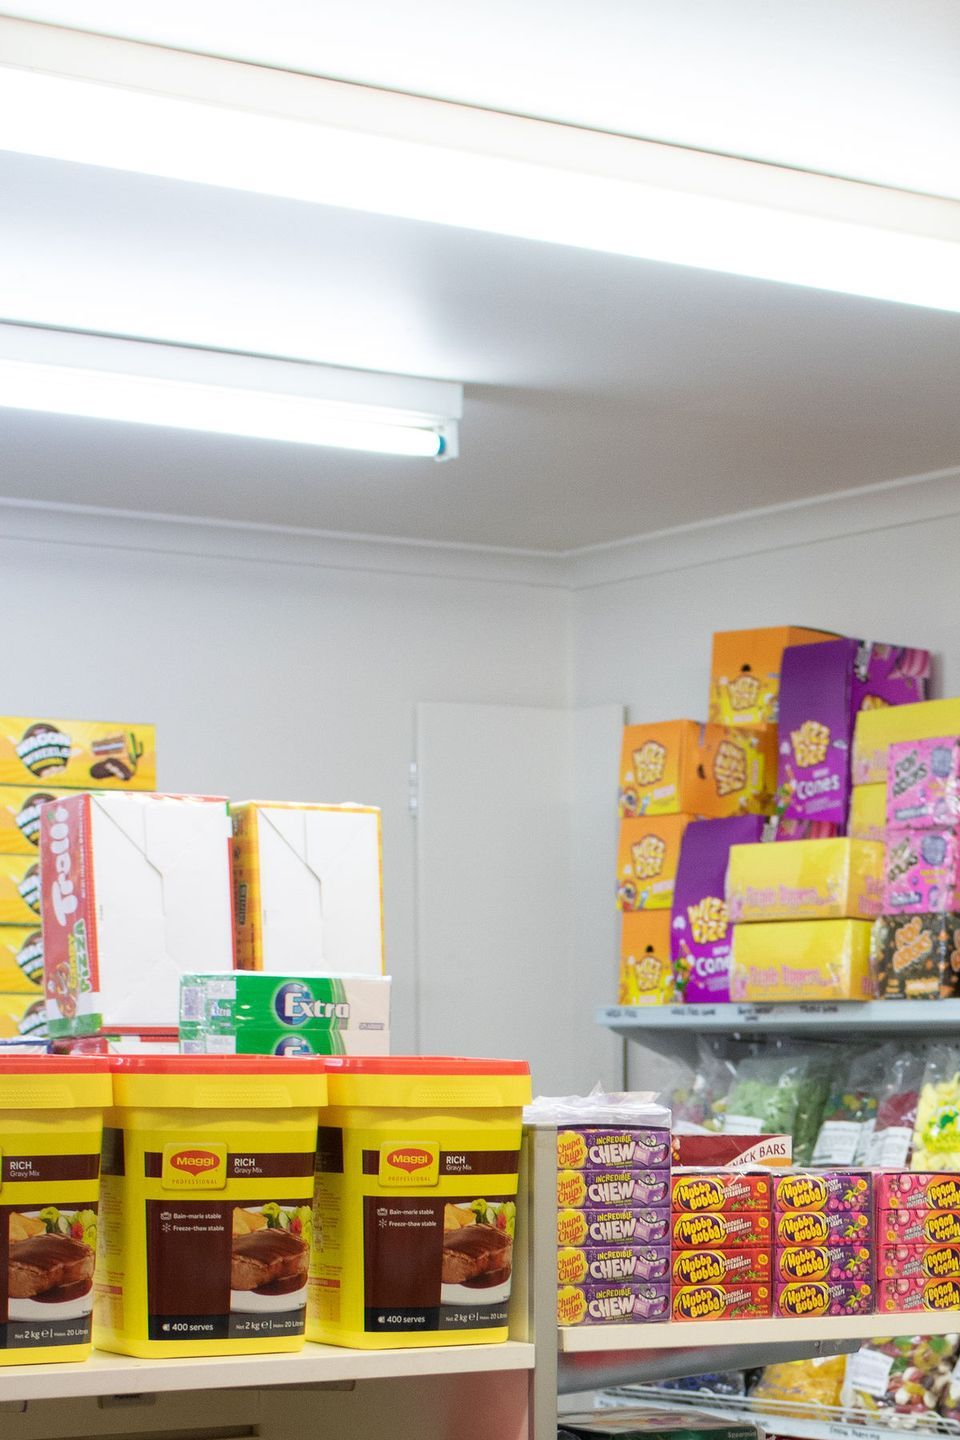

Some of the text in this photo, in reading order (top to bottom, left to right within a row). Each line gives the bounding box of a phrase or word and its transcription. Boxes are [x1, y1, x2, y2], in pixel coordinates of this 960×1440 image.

[284, 991, 351, 1019] Extra
[597, 1134, 633, 1145] INCREDIBLE
[589, 1142, 637, 1164] CHEW
[759, 1143, 787, 1156] BARS
[9, 1160, 32, 1170] RICH
[176, 1155, 214, 1168] Maggi
[234, 1158, 255, 1167] RICH
[392, 1153, 428, 1166] Maggi
[446, 1155, 466, 1165] RICH
[10, 1170, 29, 1178] Gravy
[234, 1166, 263, 1175] Gravy Mix
[446, 1165, 463, 1173] Gravy
[588, 1180, 636, 1203] CHEW
[680, 1181, 711, 1199] Hubba
[783, 1179, 814, 1199] Hubba
[689, 1191, 721, 1211] Bubba
[793, 1188, 823, 1208] Bubba
[173, 1212, 222, 1220] Bain-marie stable
[389, 1208, 434, 1216] Bain-marie stable
[597, 1212, 633, 1222] INCREDIBLE
[173, 1224, 225, 1232] Freeze-thaw stable
[388, 1219, 437, 1228] Freeze-thaw stable
[589, 1218, 637, 1242] CHEW
[682, 1216, 712, 1235] Hubba
[785, 1216, 815, 1235] Hubba
[691, 1227, 722, 1246] Bubba
[794, 1224, 824, 1244] Bubba
[589, 1295, 636, 1319] CHEW
[386, 1315, 426, 1324] 400 serves
[171, 1323, 214, 1332] 400 serves
